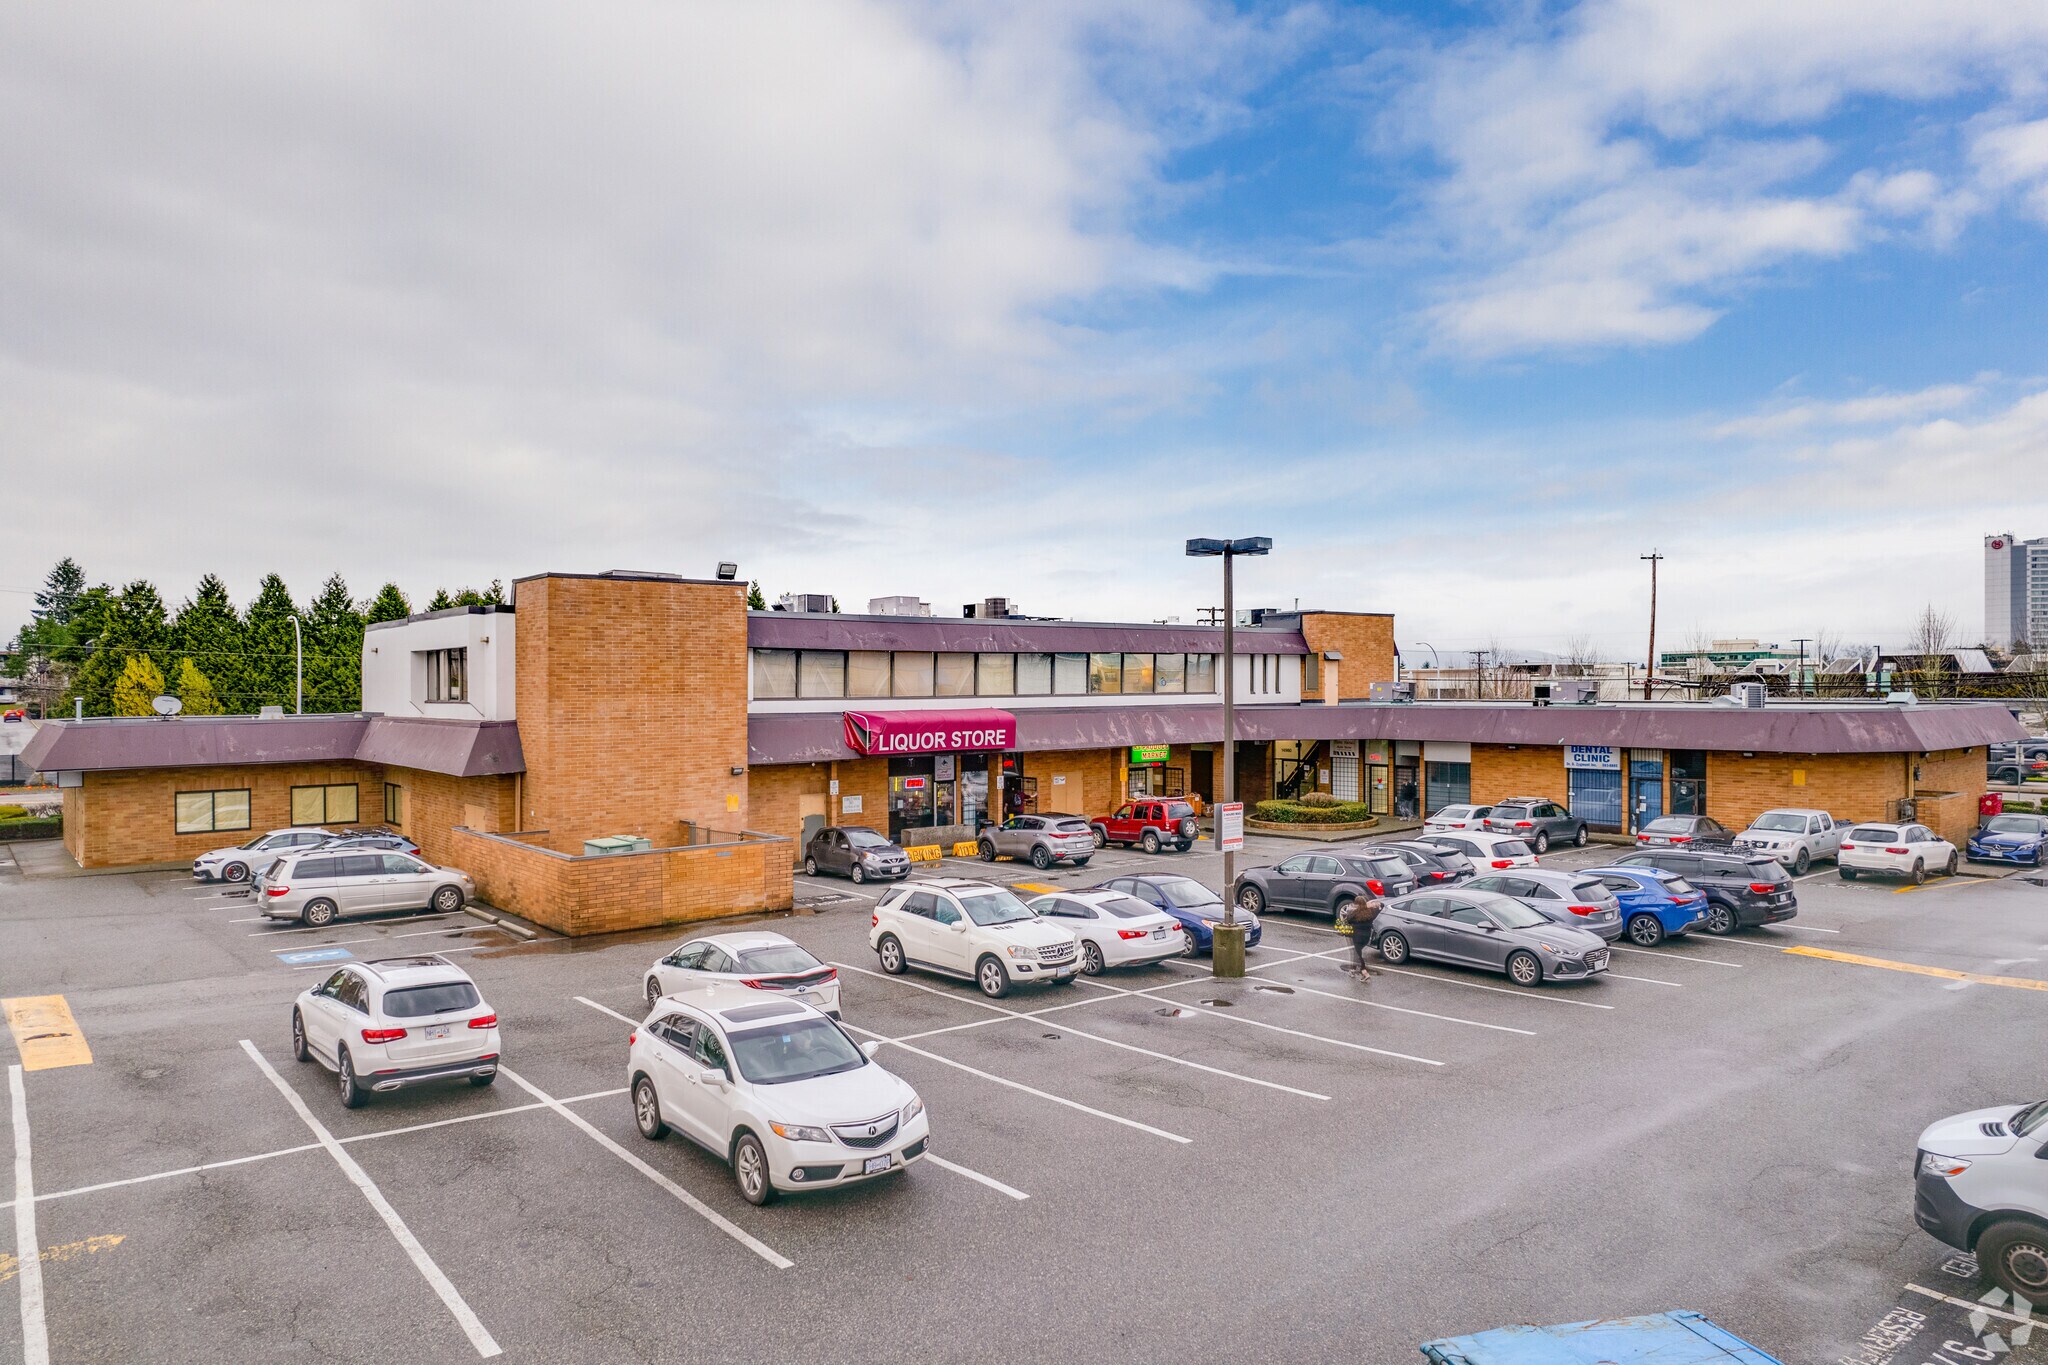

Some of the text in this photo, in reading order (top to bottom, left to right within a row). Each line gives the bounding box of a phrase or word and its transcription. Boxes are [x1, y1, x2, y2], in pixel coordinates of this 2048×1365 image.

[879, 729, 1006, 751] LIQUOR STORE
[1571, 746, 1612, 754] DENTAL
[1574, 754, 1610, 762] CLINIC
[907, 848, 941, 861] ARKING
